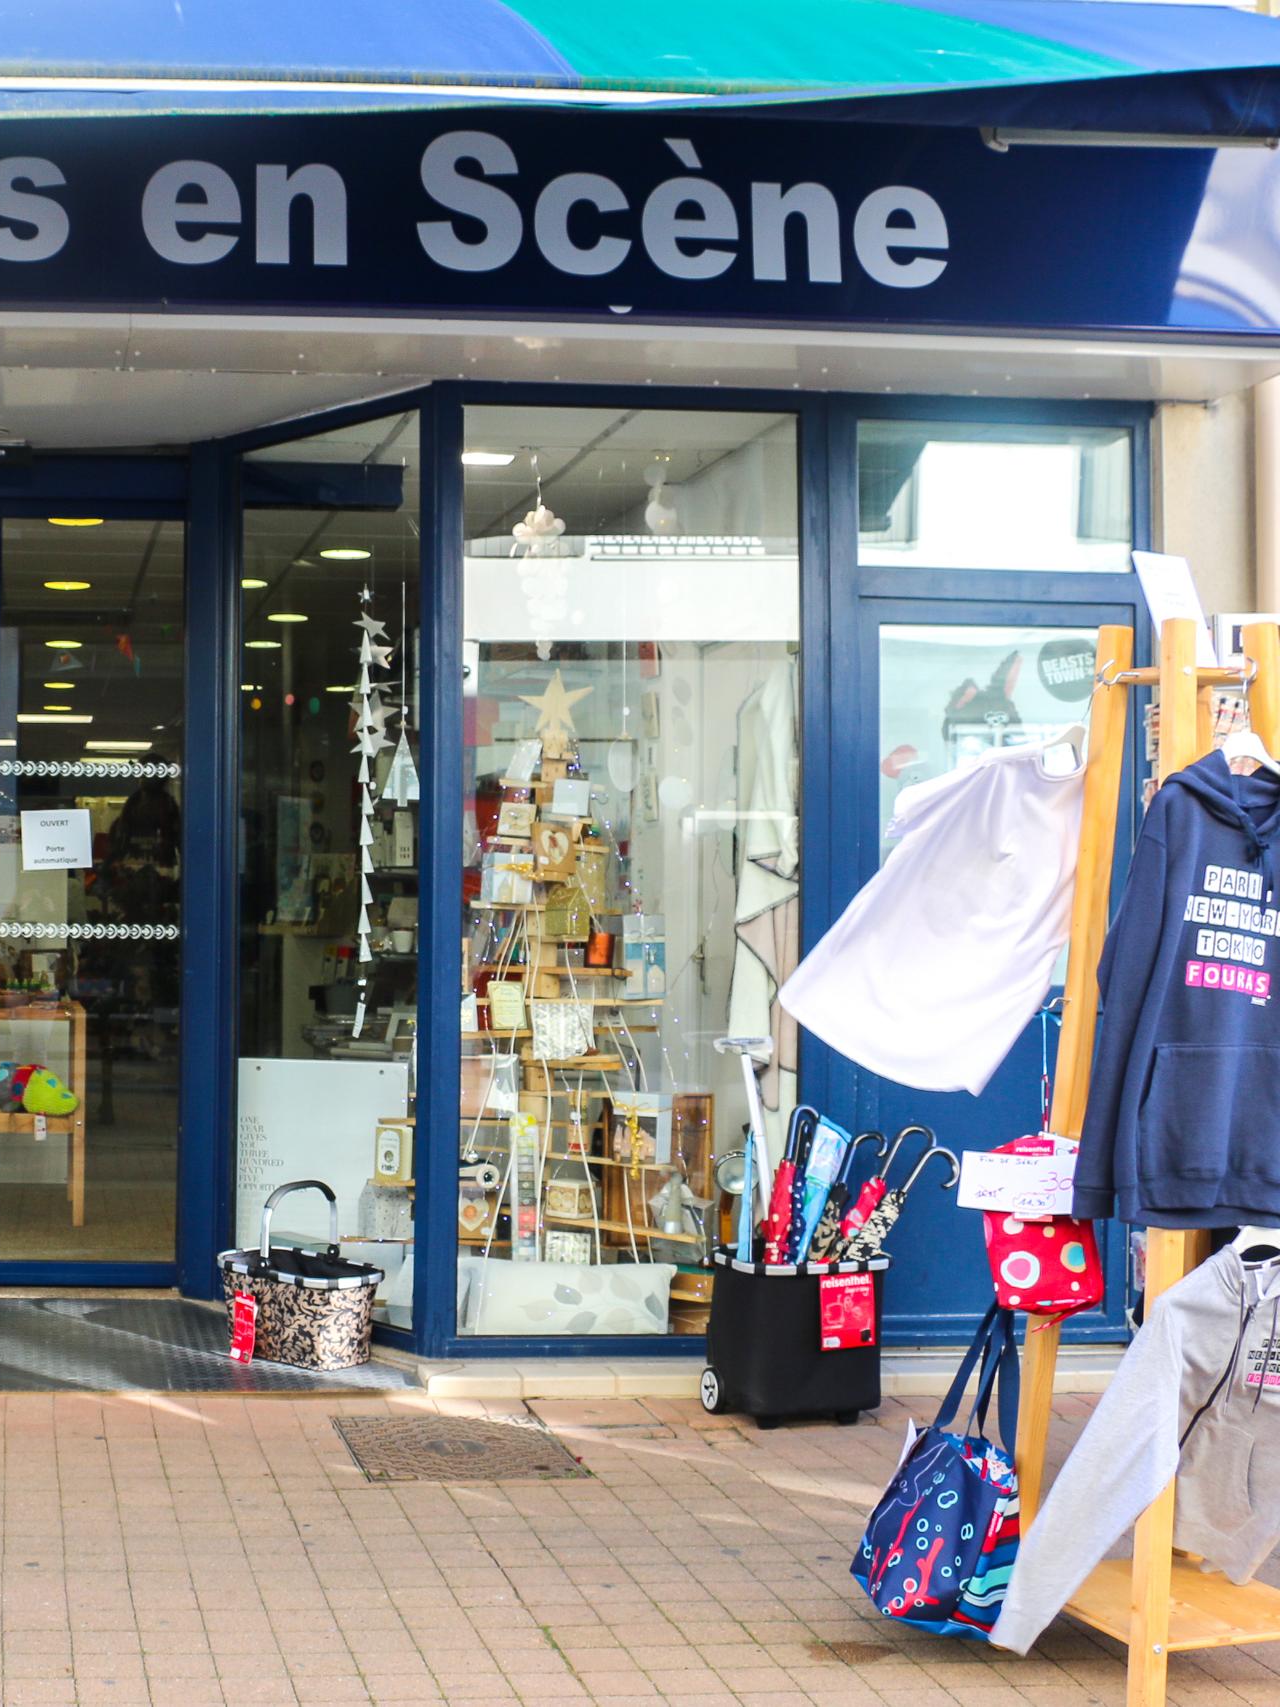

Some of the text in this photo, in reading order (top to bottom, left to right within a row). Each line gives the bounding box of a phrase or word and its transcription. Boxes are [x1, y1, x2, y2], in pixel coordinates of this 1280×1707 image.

[141, 160, 348, 266] en
[416, 130, 950, 288] Scène
[1041, 652, 1095, 673] BEASTS
[1045, 668, 1085, 685] TOWN
[40, 819, 69, 827] OUVERT
[33, 856, 79, 865] automatique
[1206, 869, 1262, 899] PARI
[1186, 899, 1280, 934] EW-YOR
[1200, 934, 1264, 961] TOKYO
[1188, 964, 1268, 995] FOURAS
[240, 1125, 264, 1133] YEAR
[240, 1133, 267, 1141] GIVES
[240, 1150, 269, 1158] THREE
[240, 1158, 284, 1166] HUNDRED
